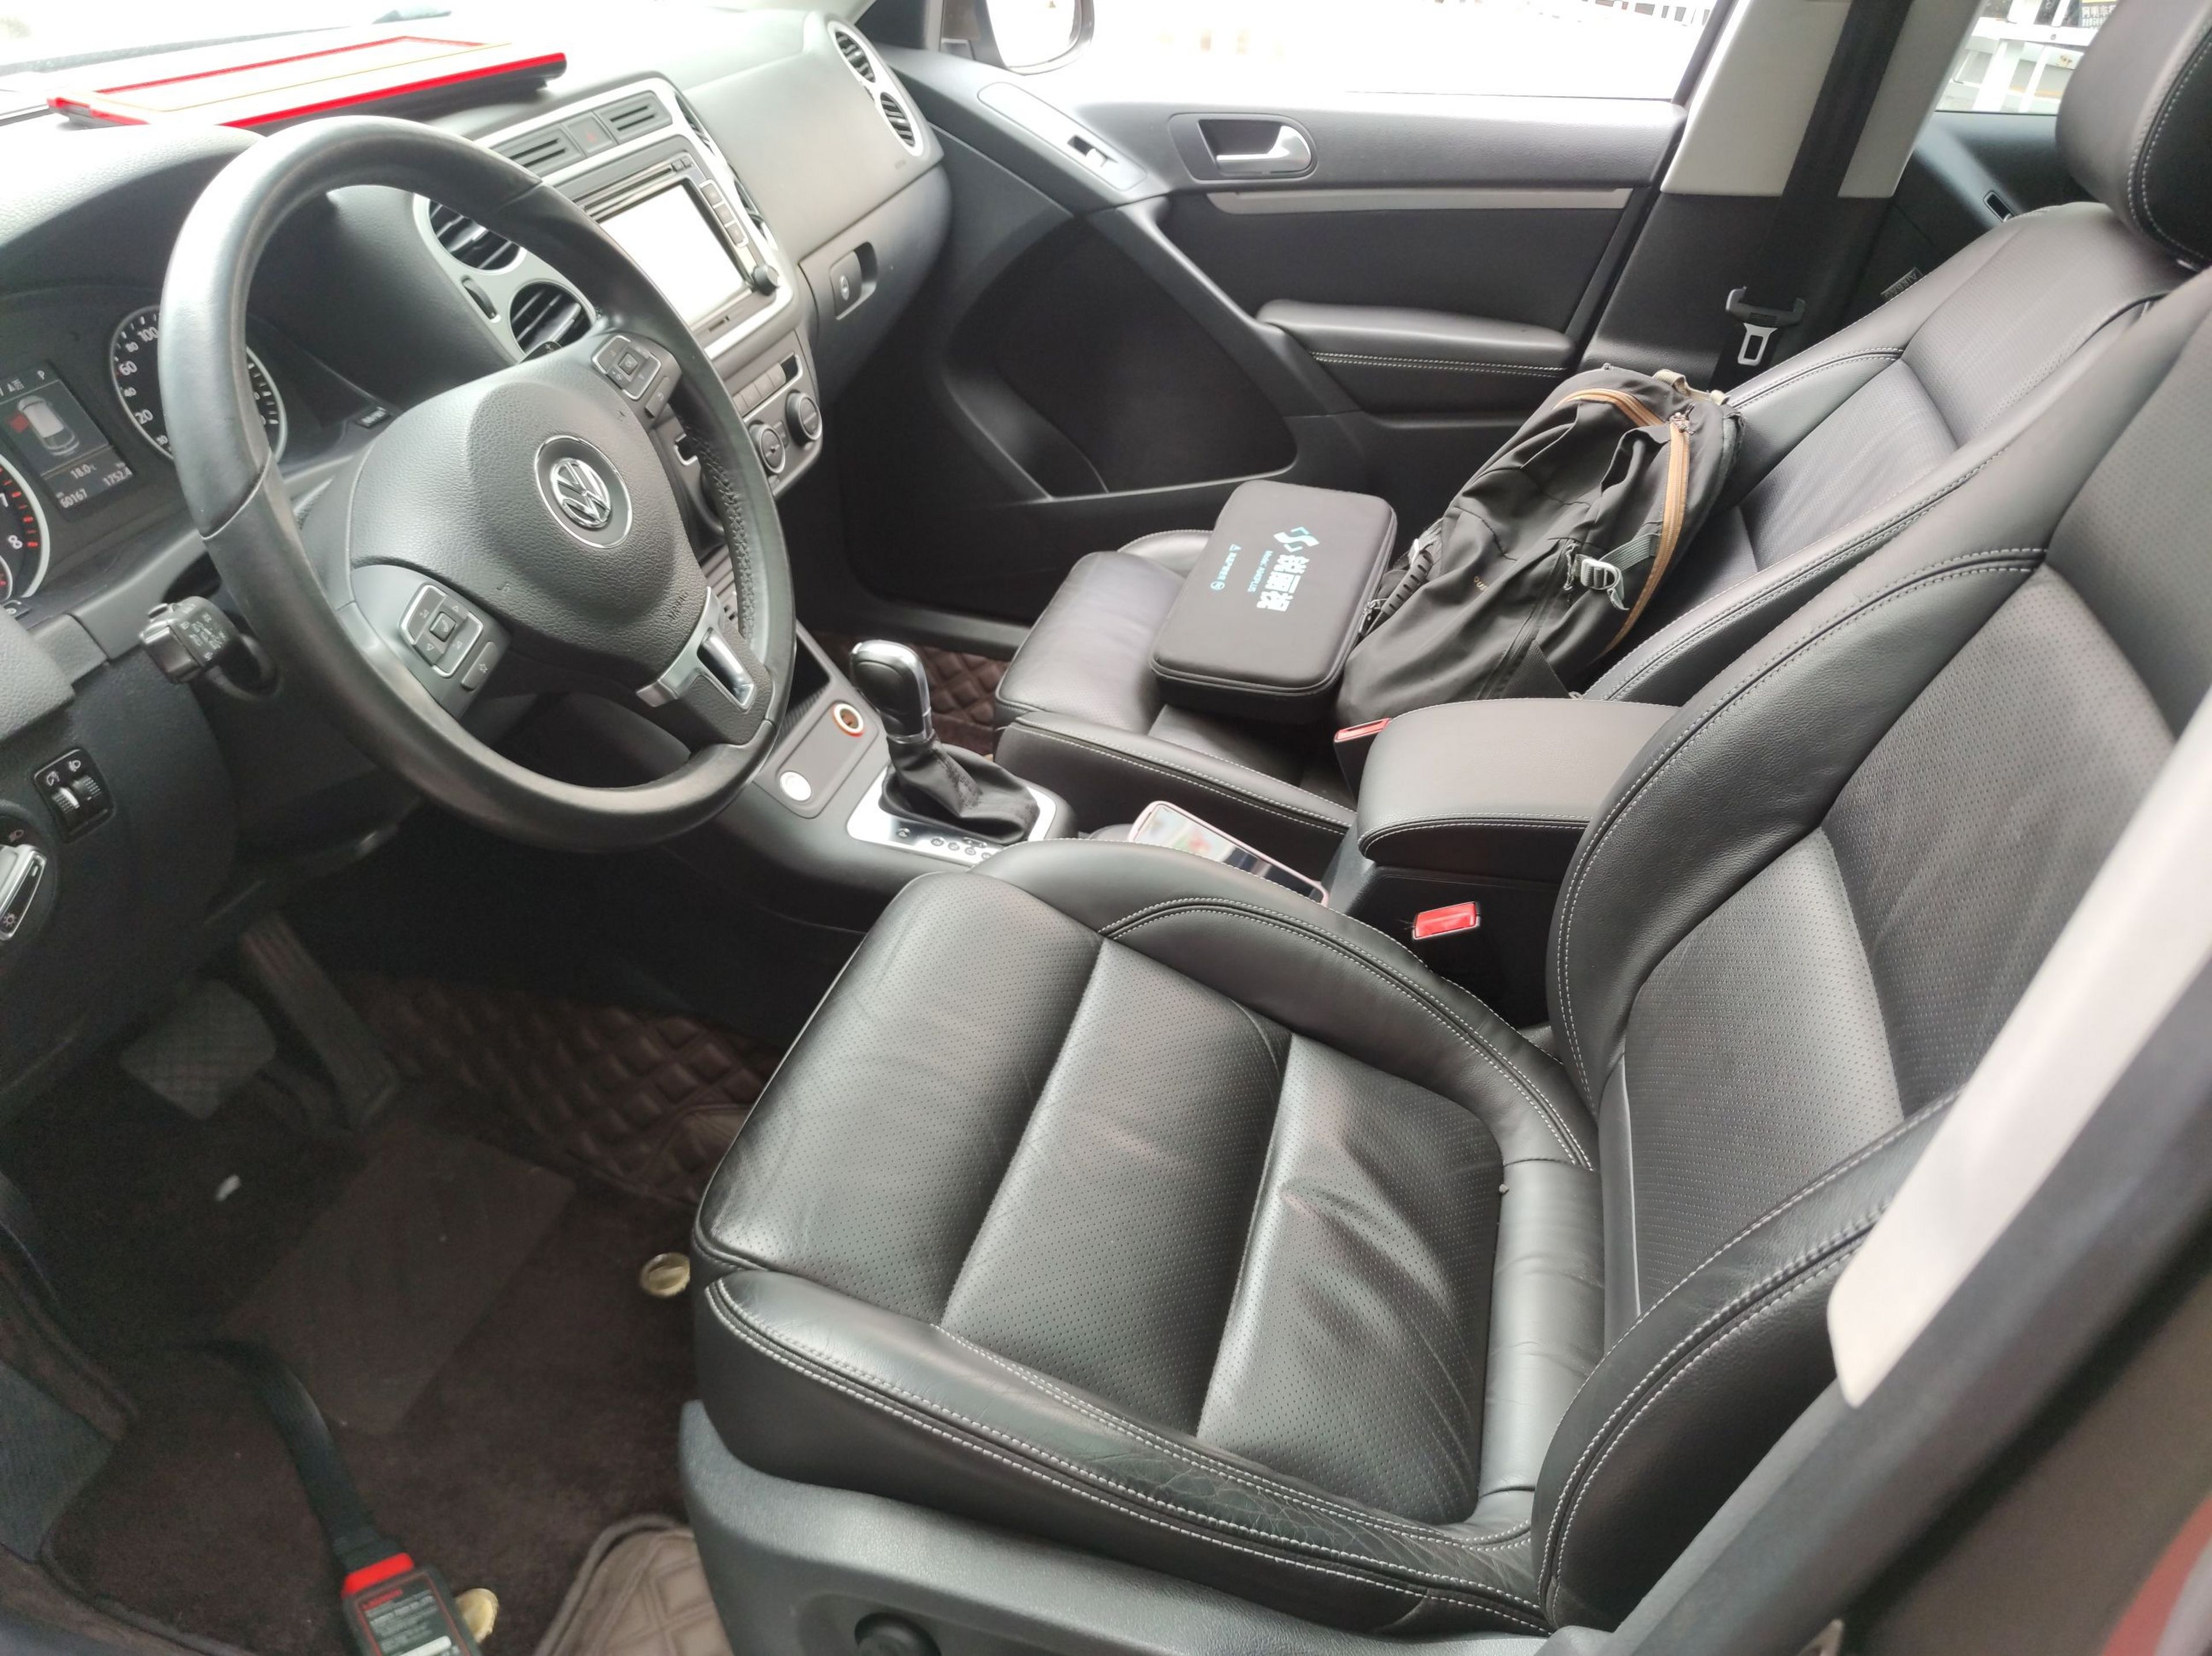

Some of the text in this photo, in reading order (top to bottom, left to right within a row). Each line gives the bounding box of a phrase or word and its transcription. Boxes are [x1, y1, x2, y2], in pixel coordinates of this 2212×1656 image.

[138, 326, 158, 342] 100
[37, 370, 45, 380] P
[119, 361, 137, 375] 60
[135, 409, 153, 424] 20
[7, 535, 23, 550] 8
